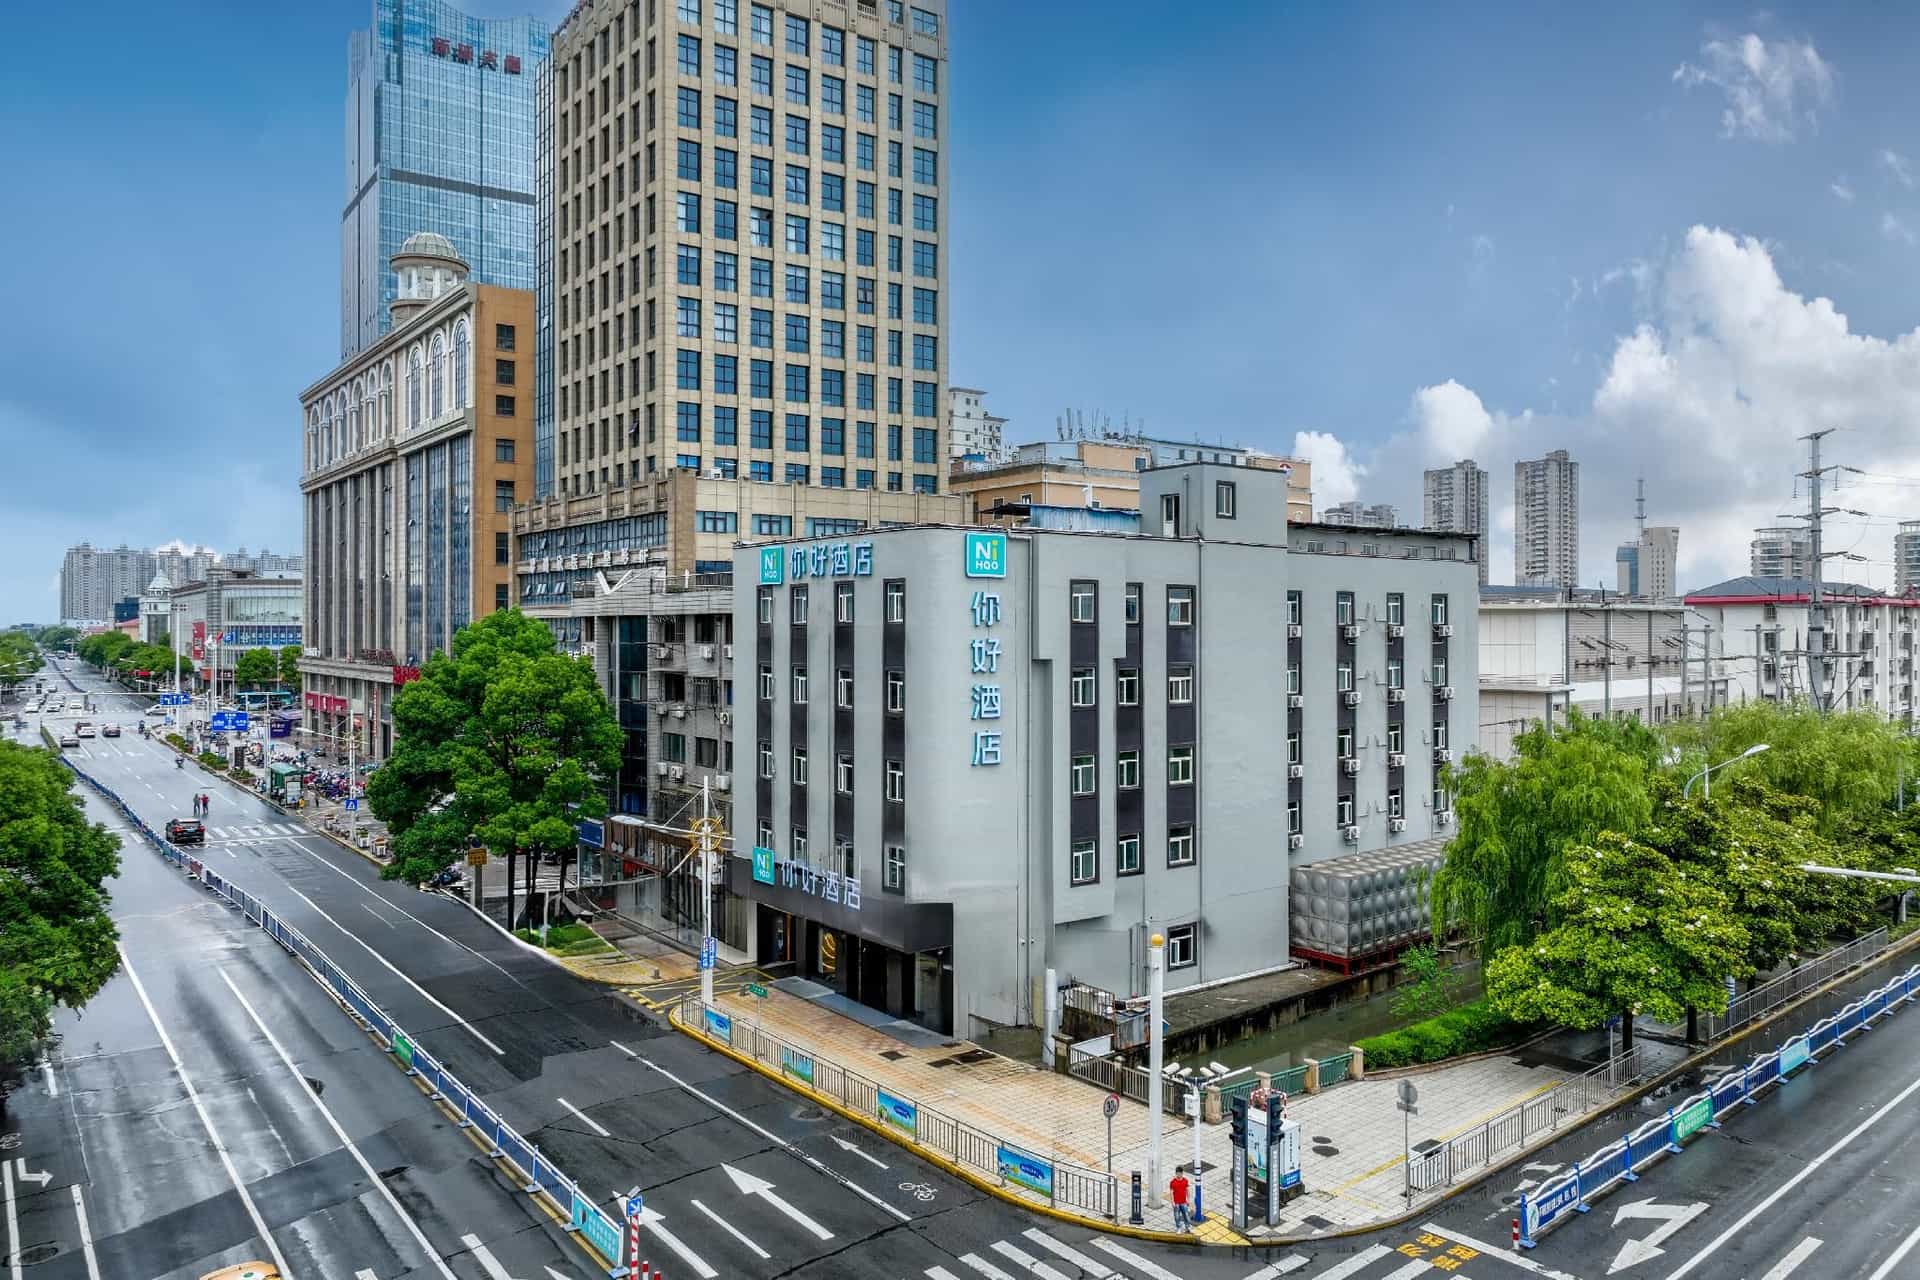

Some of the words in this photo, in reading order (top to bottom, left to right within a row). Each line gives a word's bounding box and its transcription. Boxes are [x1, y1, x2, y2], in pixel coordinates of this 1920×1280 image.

[790, 540, 873, 578] 你好酒店
[971, 591, 1002, 766] 你好酒店
[781, 856, 862, 911] 你好酒店
